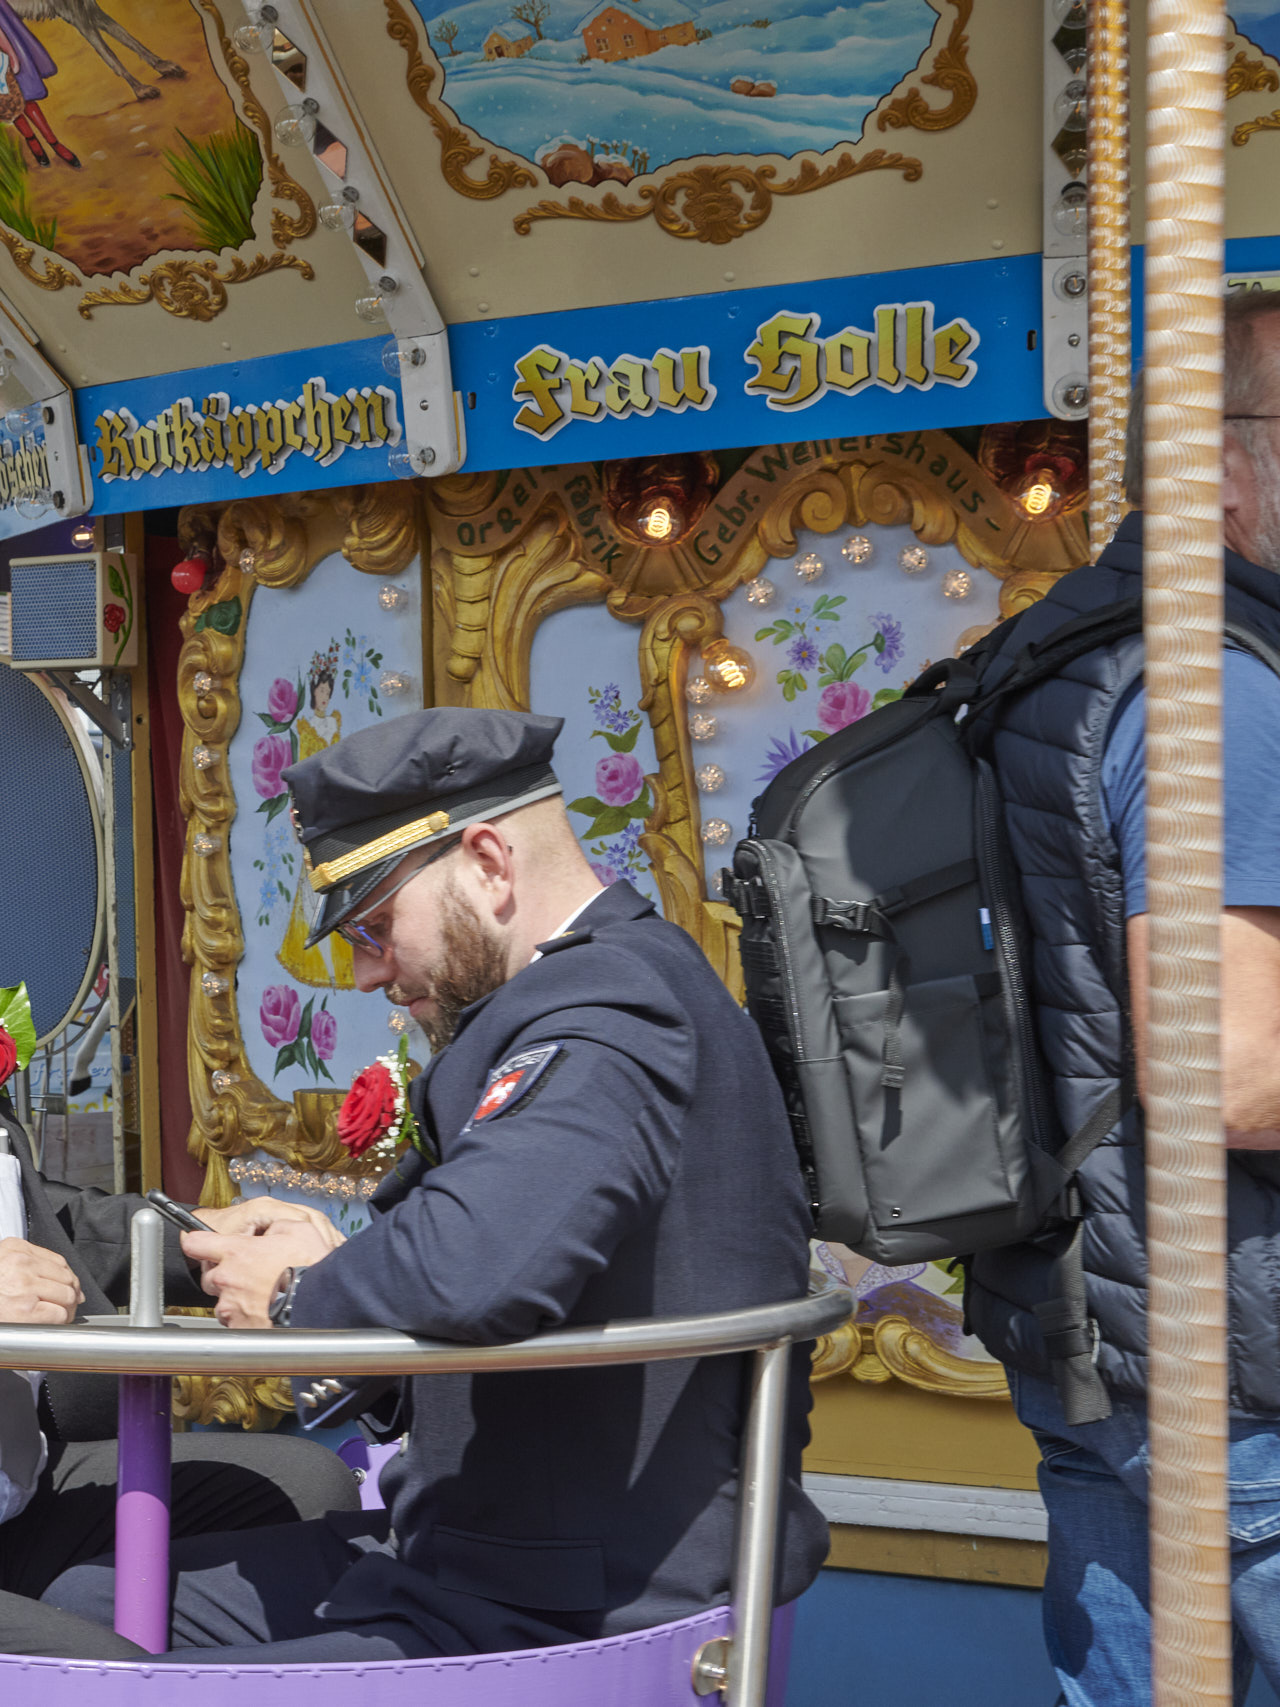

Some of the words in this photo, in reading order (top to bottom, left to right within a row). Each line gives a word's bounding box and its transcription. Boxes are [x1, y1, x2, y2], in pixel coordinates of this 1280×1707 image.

[513, 347, 713, 438] Frau
[744, 303, 977, 409] Holle
[94, 380, 397, 480] Rotkäppchen
